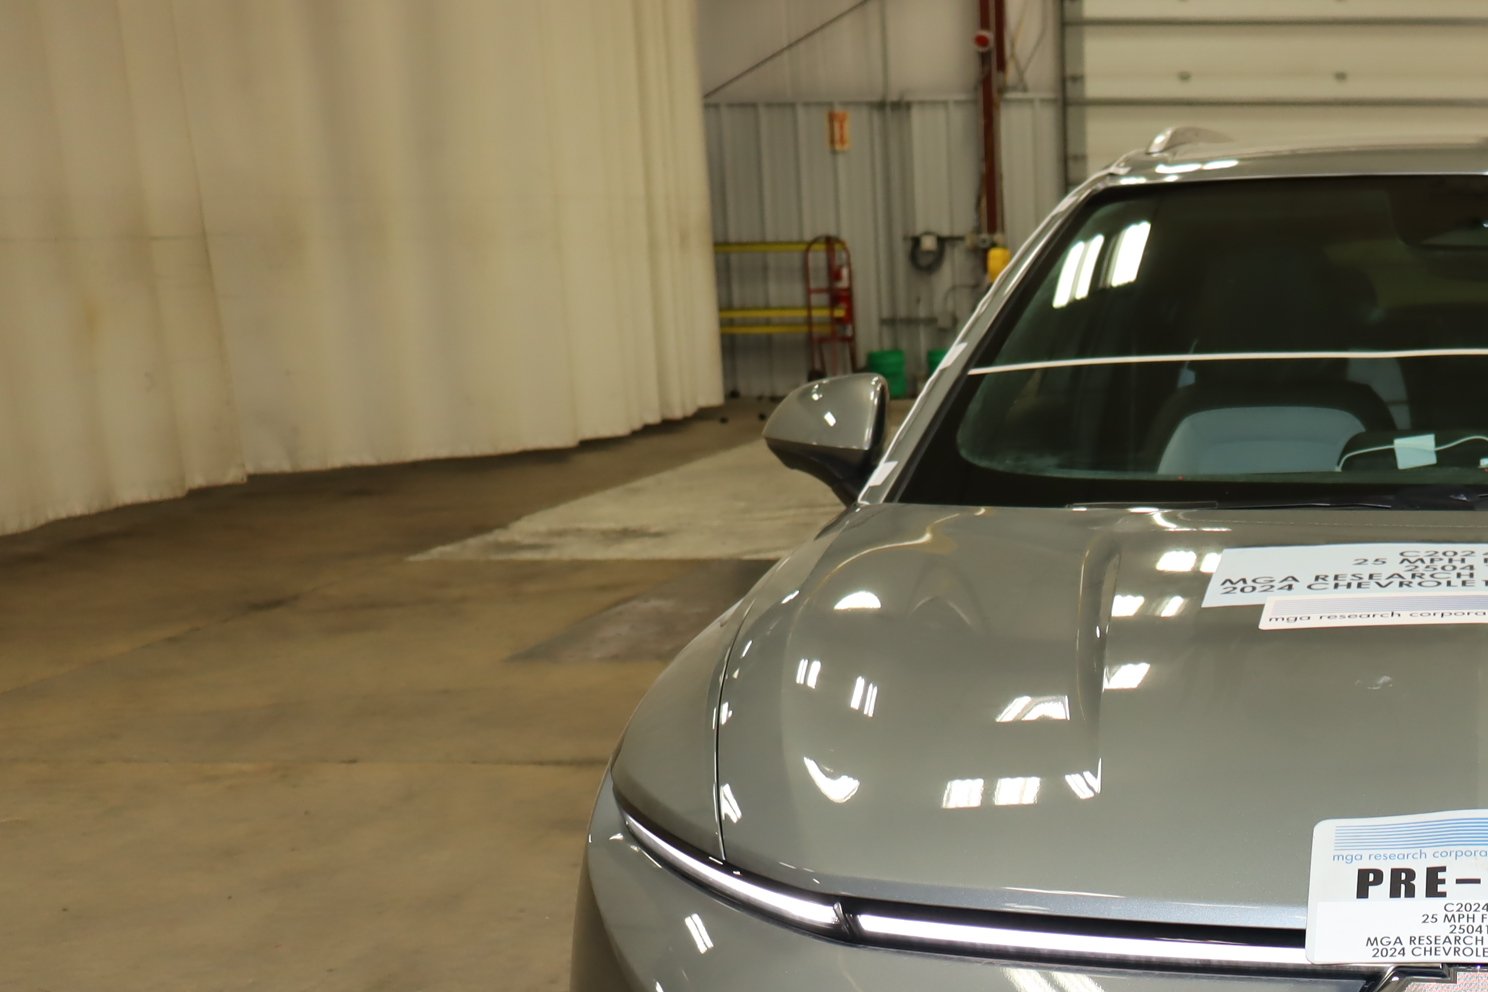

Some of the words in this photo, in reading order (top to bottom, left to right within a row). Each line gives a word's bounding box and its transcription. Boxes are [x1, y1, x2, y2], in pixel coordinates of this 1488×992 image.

[1352, 558, 1387, 566] 25
[1399, 557, 1466, 565] MPH
[1220, 575, 1300, 586] MGA
[1314, 572, 1475, 583] RESEARCH
[1220, 583, 1295, 595] 2024
[1268, 615, 1311, 623] mga
[1319, 611, 1401, 620] research
[1332, 853, 1363, 864] mga
[1368, 849, 1427, 861] research
[1421, 914, 1438, 924] 25
[1443, 914, 1476, 924] MPH
[1365, 936, 1403, 947] MGA
[1409, 935, 1484, 947] RESEARCH
[1372, 947, 1406, 958] 2024
